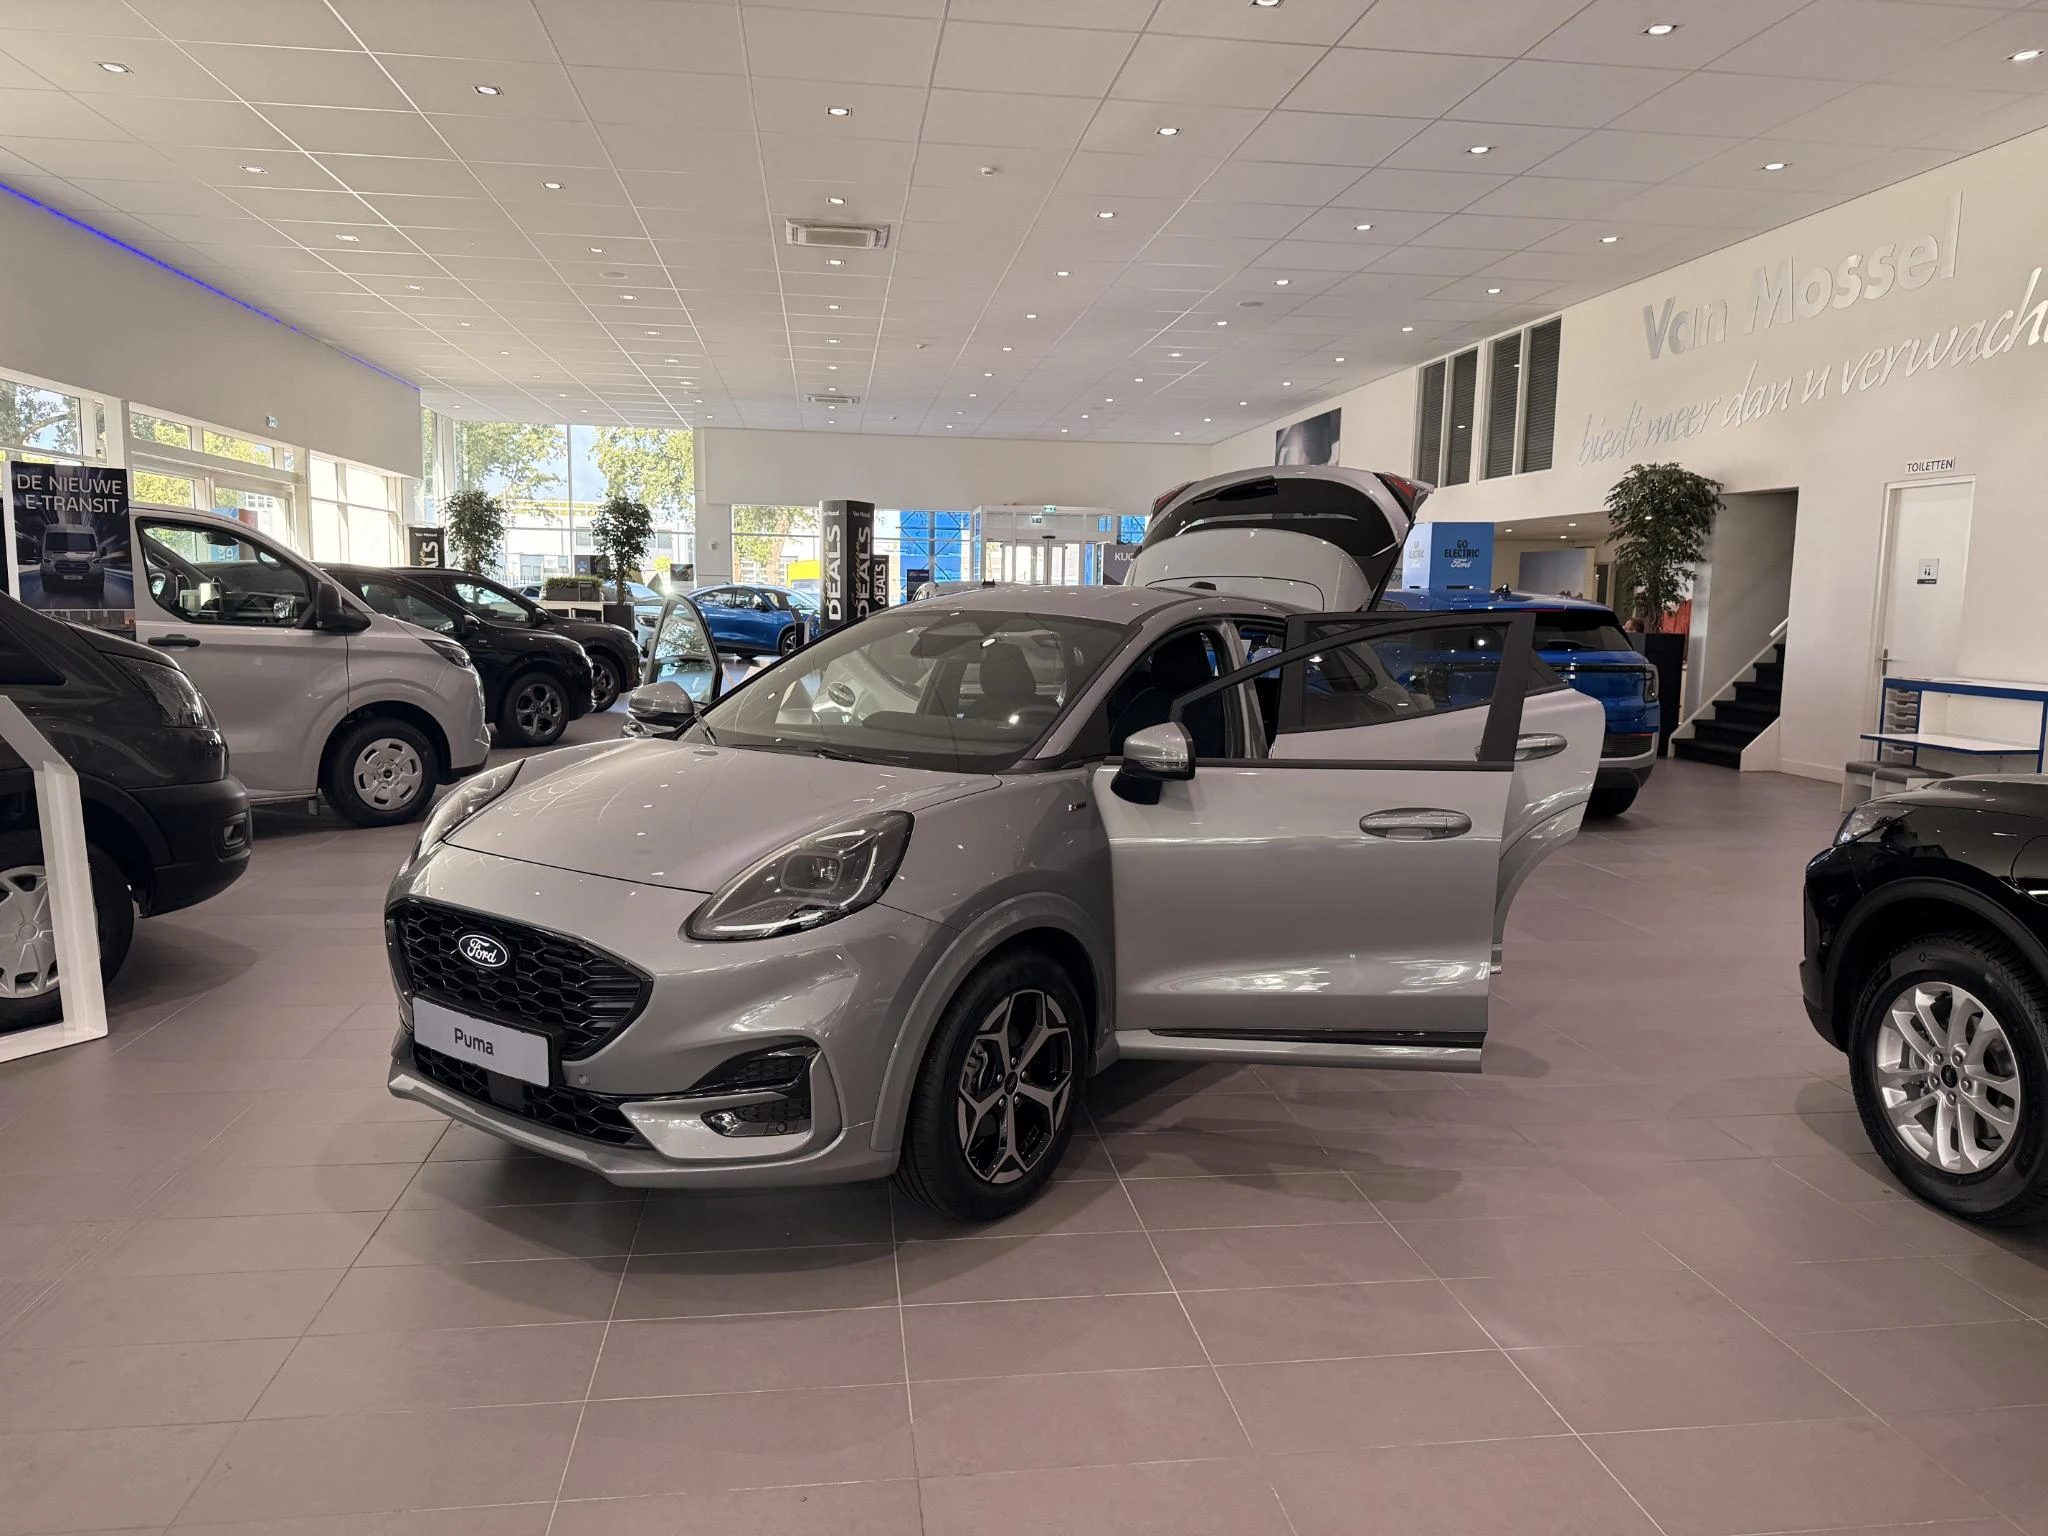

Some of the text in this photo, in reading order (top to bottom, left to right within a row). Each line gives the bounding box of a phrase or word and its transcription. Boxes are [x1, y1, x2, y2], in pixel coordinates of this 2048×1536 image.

[1642, 189, 1964, 361] Van Mossel
[1577, 266, 2048, 467] biedt meer dan u verwach
[1907, 458, 1953, 473] TOILETTEN
[17, 473, 122, 495] DE NIEUWE
[25, 494, 120, 514] E-TRANSIT
[1444, 549, 1480, 558] ELECTRIC
[1456, 539, 1468, 549] GO
[826, 524, 842, 621] DEALS
[857, 525, 871, 618] DEALS
[1450, 558, 1472, 568] Ford
[467, 938, 498, 964] Ford
[454, 1027, 495, 1056] Puma
